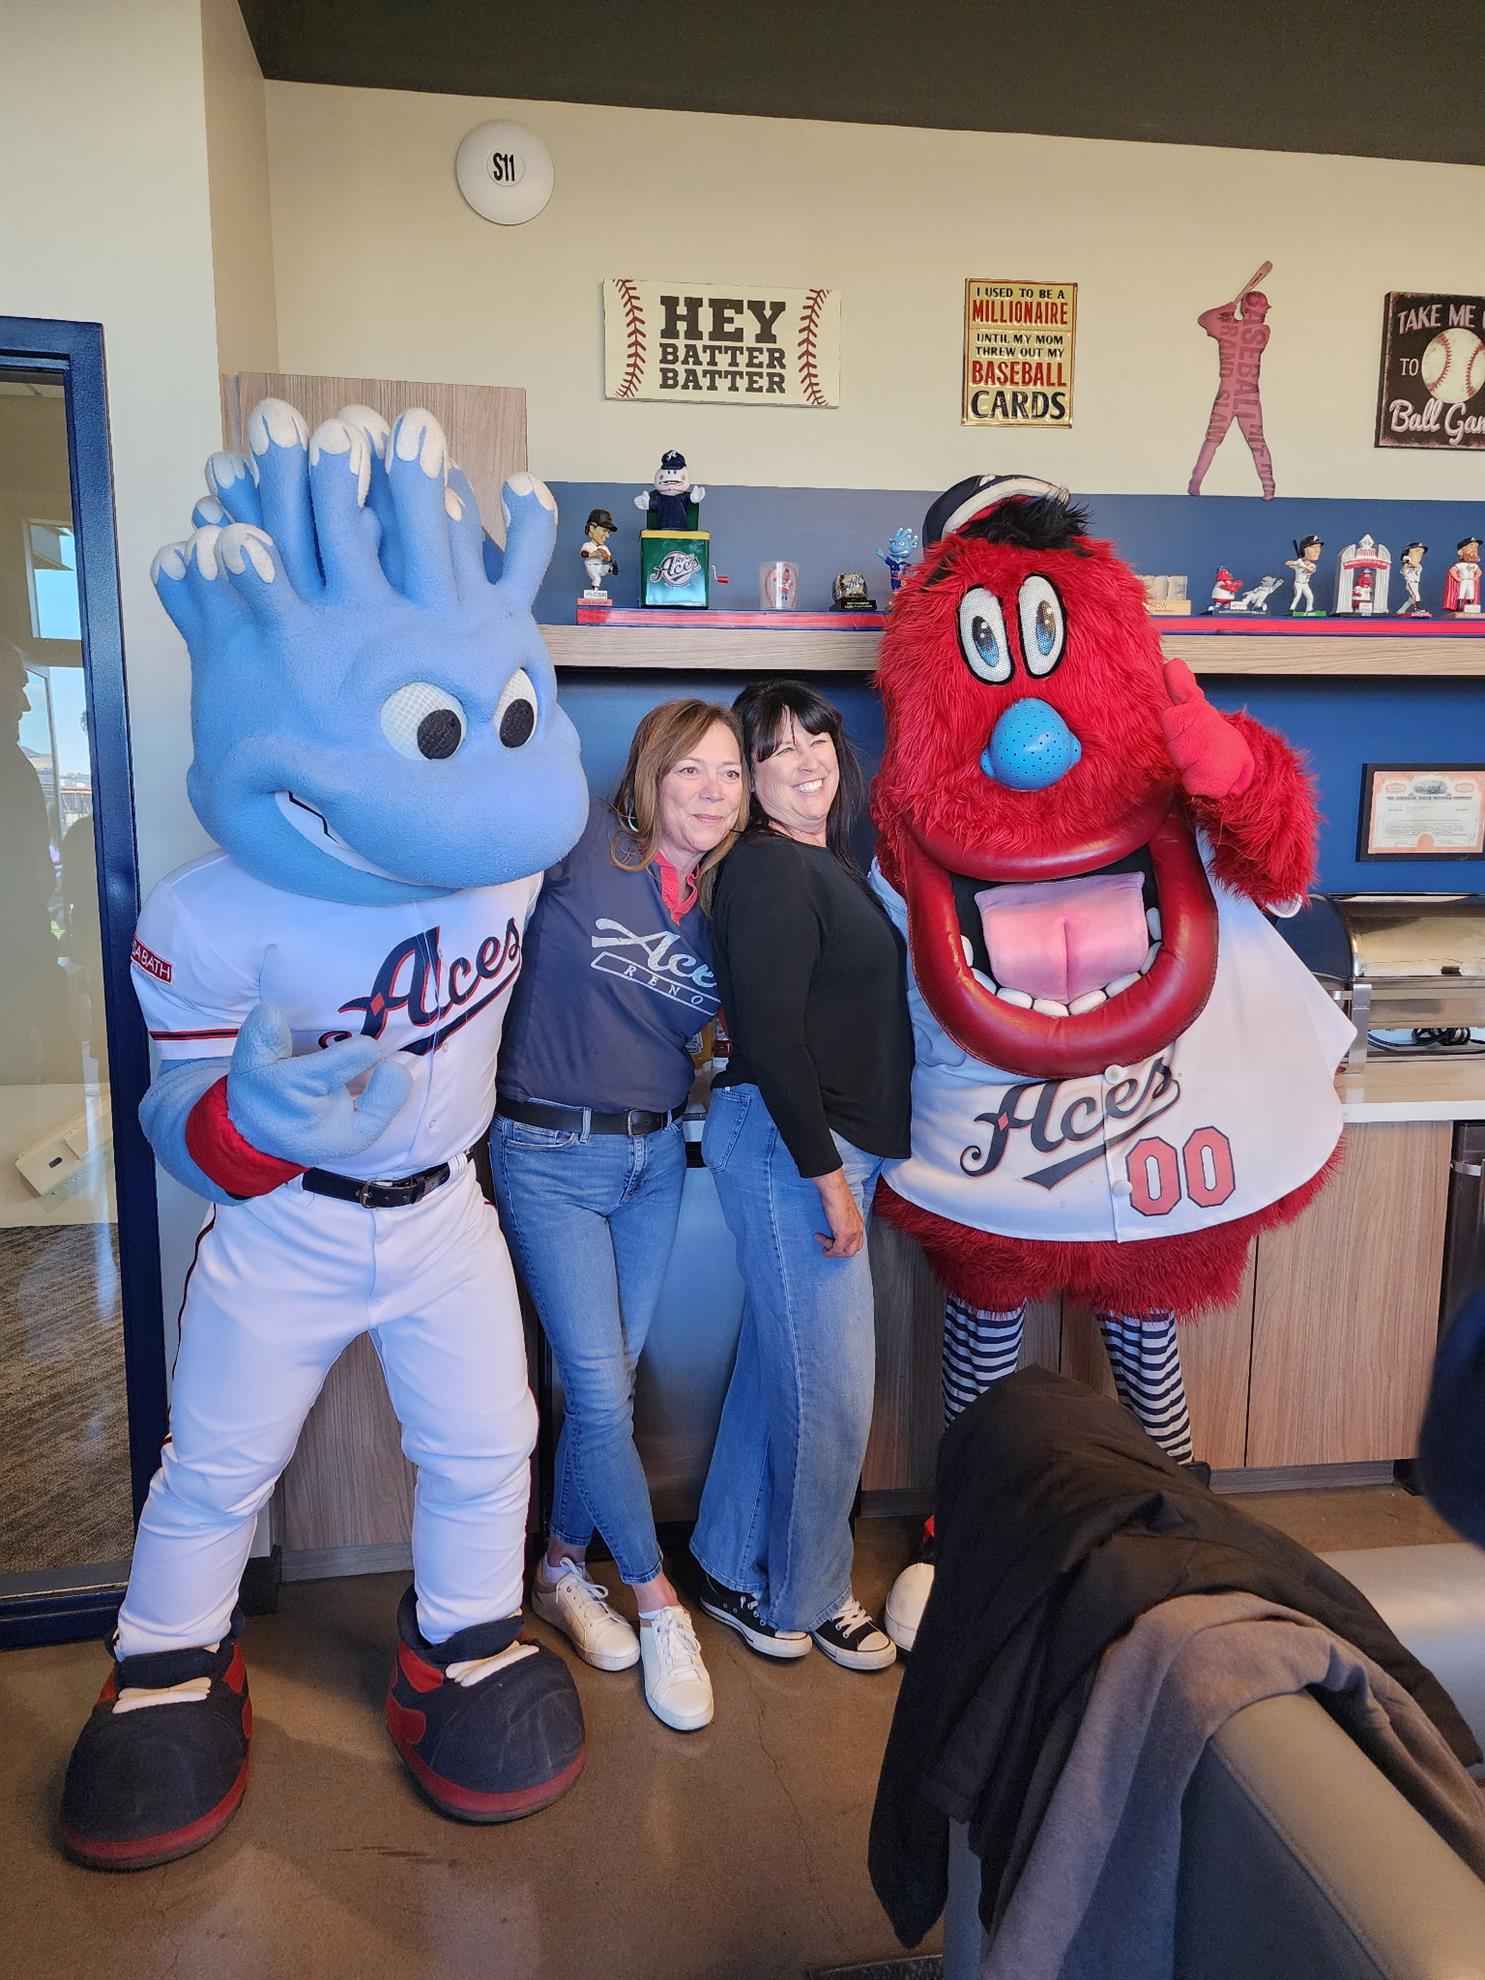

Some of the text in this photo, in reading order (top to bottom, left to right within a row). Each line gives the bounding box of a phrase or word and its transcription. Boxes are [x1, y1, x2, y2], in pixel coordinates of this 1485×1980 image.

[492, 152, 515, 182] S11
[976, 287, 1065, 300] I USED TO BE A
[660, 295, 786, 344] HEY
[972, 299, 1068, 325] MILLIONAIRE
[1398, 304, 1443, 334] TAKE
[1449, 303, 1476, 328] ME
[976, 333, 1063, 345] UNTIL MY MOM
[976, 346, 1065, 358] THREW OUT MY
[659, 343, 786, 369] BATTER
[1400, 358, 1419, 377] TO
[659, 367, 786, 394] BATTER
[972, 360, 1067, 387] BASEBALL
[971, 390, 1067, 420] CARDS
[1389, 398, 1443, 433] Ball
[650, 553, 701, 582] Aces
[592, 918, 718, 988] Ace
[318, 917, 521, 1054] Aces
[624, 964, 705, 1005] RENO
[960, 1056, 1181, 1190] Aces
[1125, 1126, 1235, 1217] 00
